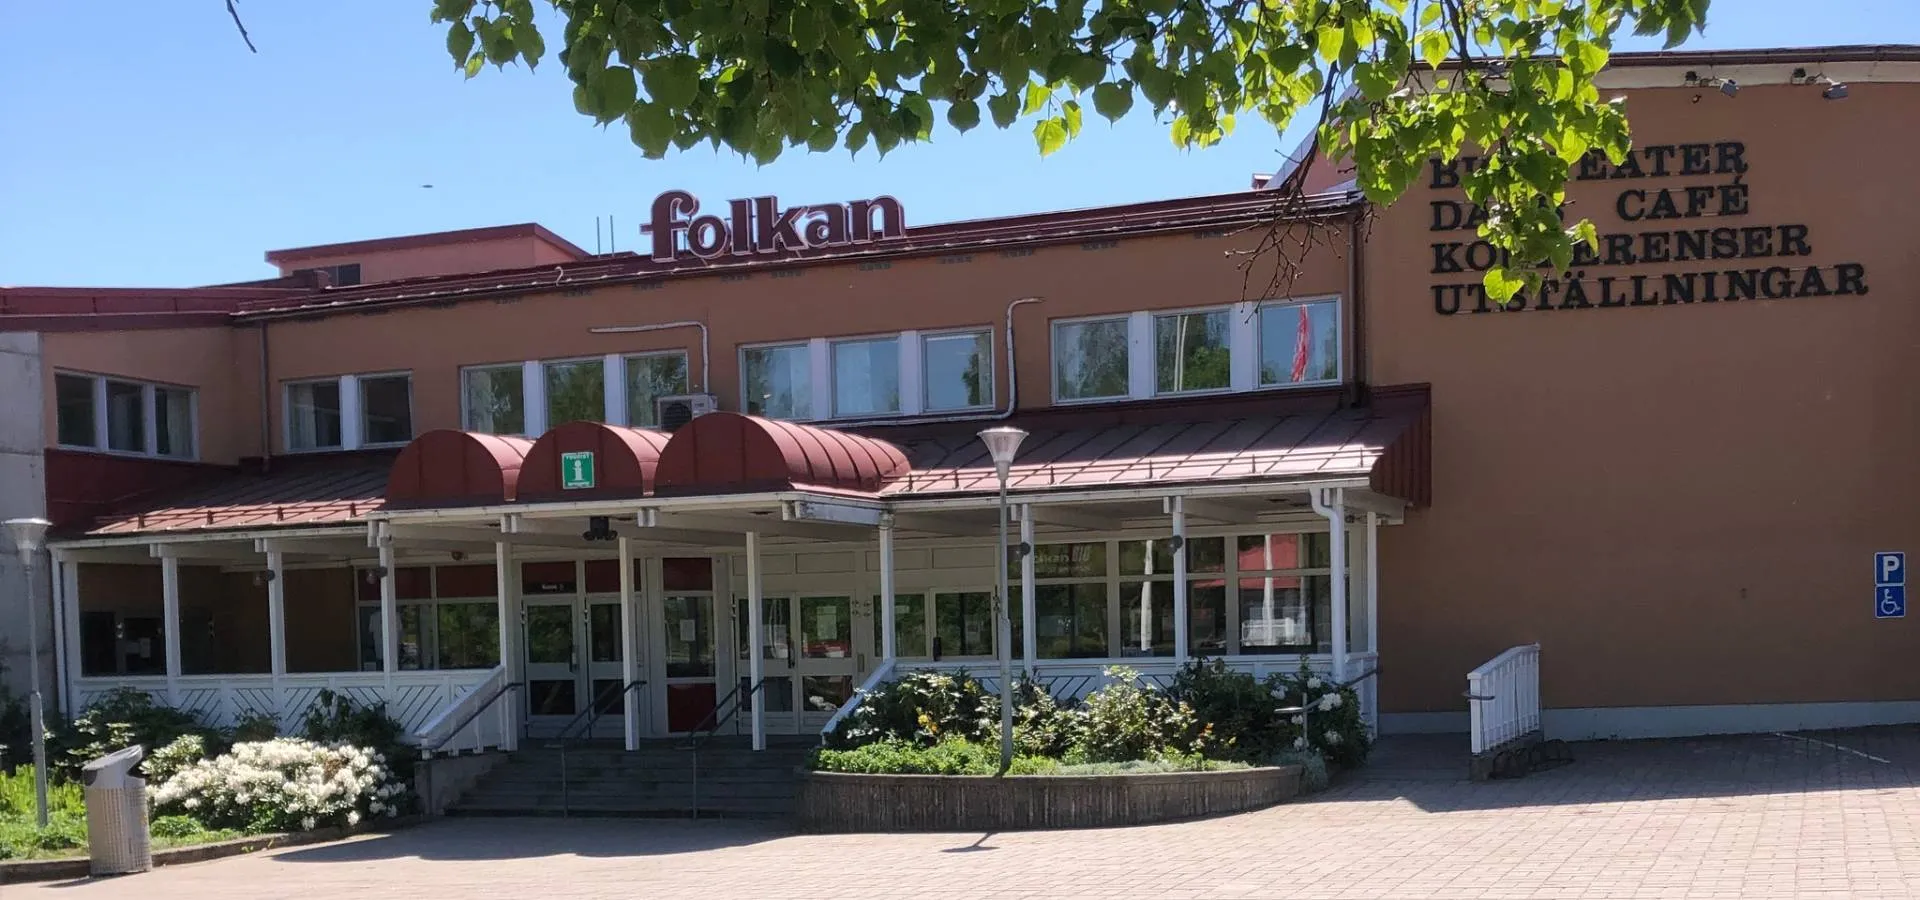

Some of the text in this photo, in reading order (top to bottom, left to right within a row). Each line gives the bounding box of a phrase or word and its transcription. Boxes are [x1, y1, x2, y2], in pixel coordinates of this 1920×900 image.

[1544, 141, 1749, 182] EATER
[639, 189, 905, 263] folkan
[1430, 174, 1749, 232] DA CAFÉ
[1430, 224, 1812, 274] KOERENSER
[1882, 555, 1900, 582] P
